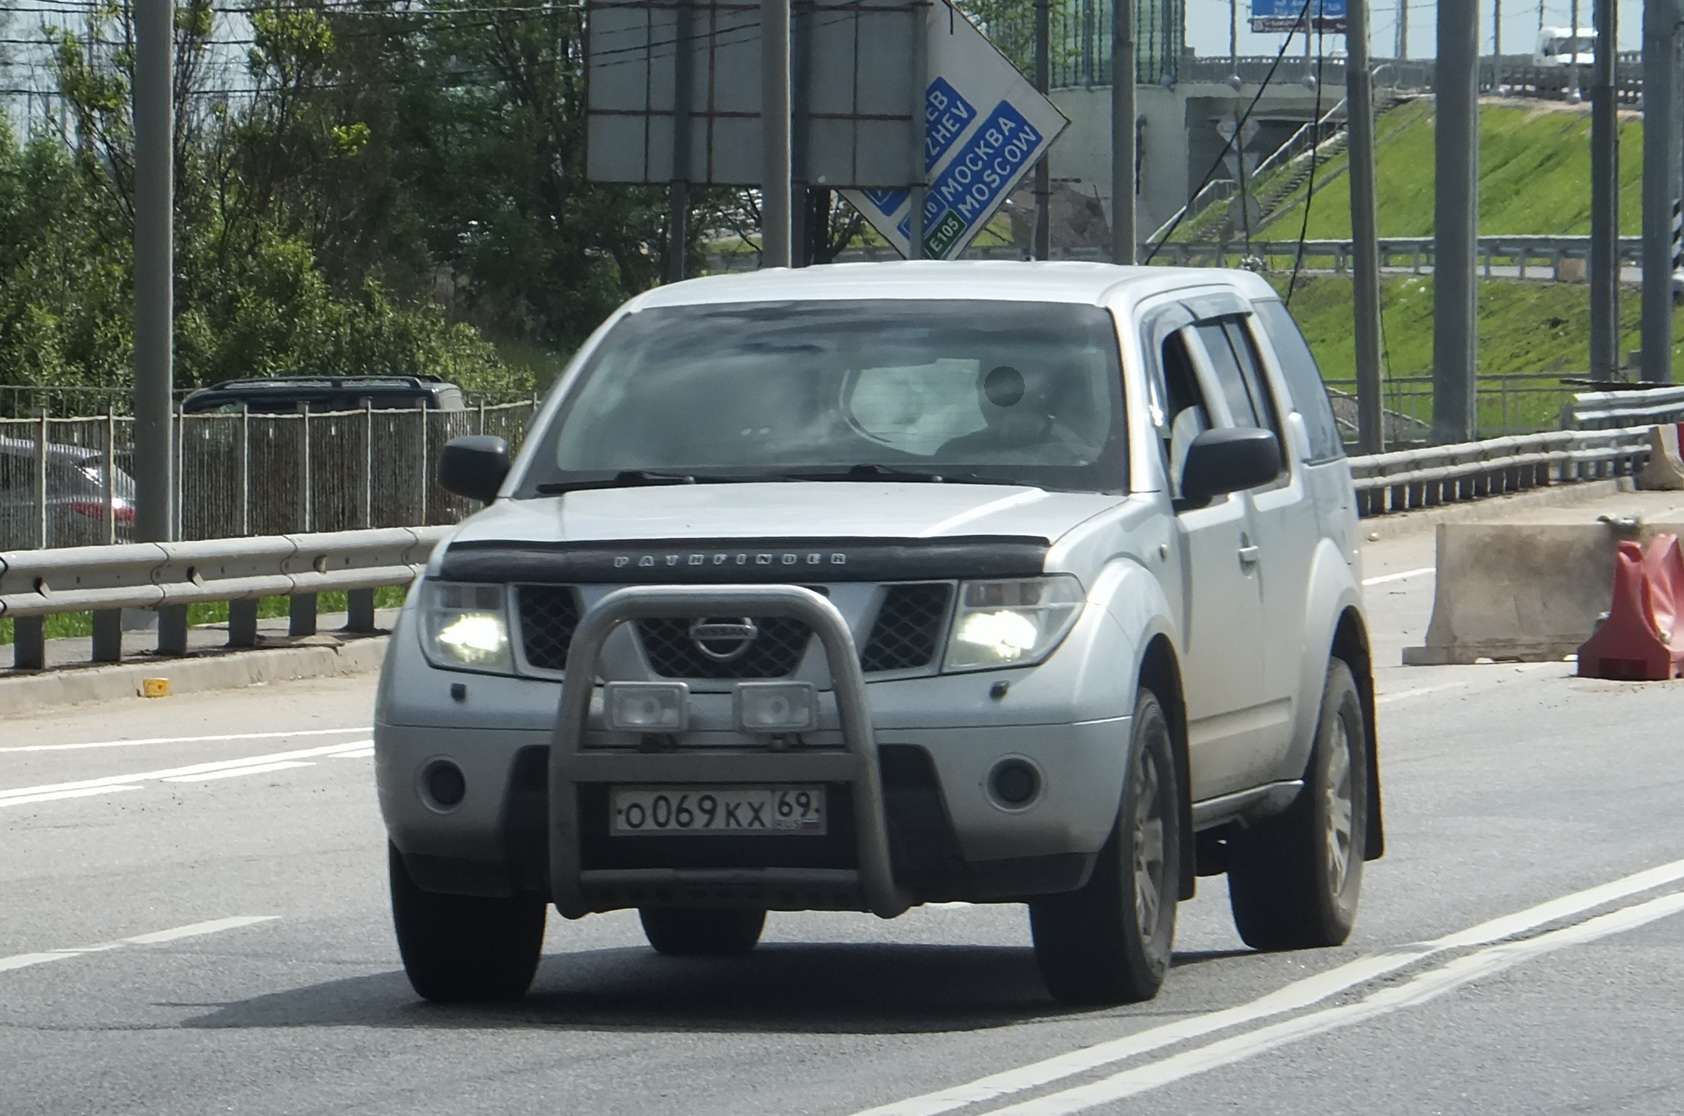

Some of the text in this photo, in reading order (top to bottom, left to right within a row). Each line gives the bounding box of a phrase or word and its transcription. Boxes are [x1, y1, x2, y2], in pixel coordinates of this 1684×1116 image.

[926, 100, 968, 162] ZHEV
[940, 116, 1016, 202] МОСКВА
[958, 125, 1037, 218] MOSCOW
[923, 202, 938, 224] 10
[929, 217, 960, 252] E105
[613, 553, 847, 568] PATHFINDER
[777, 791, 811, 818] 69
[776, 819, 801, 829] RUS
